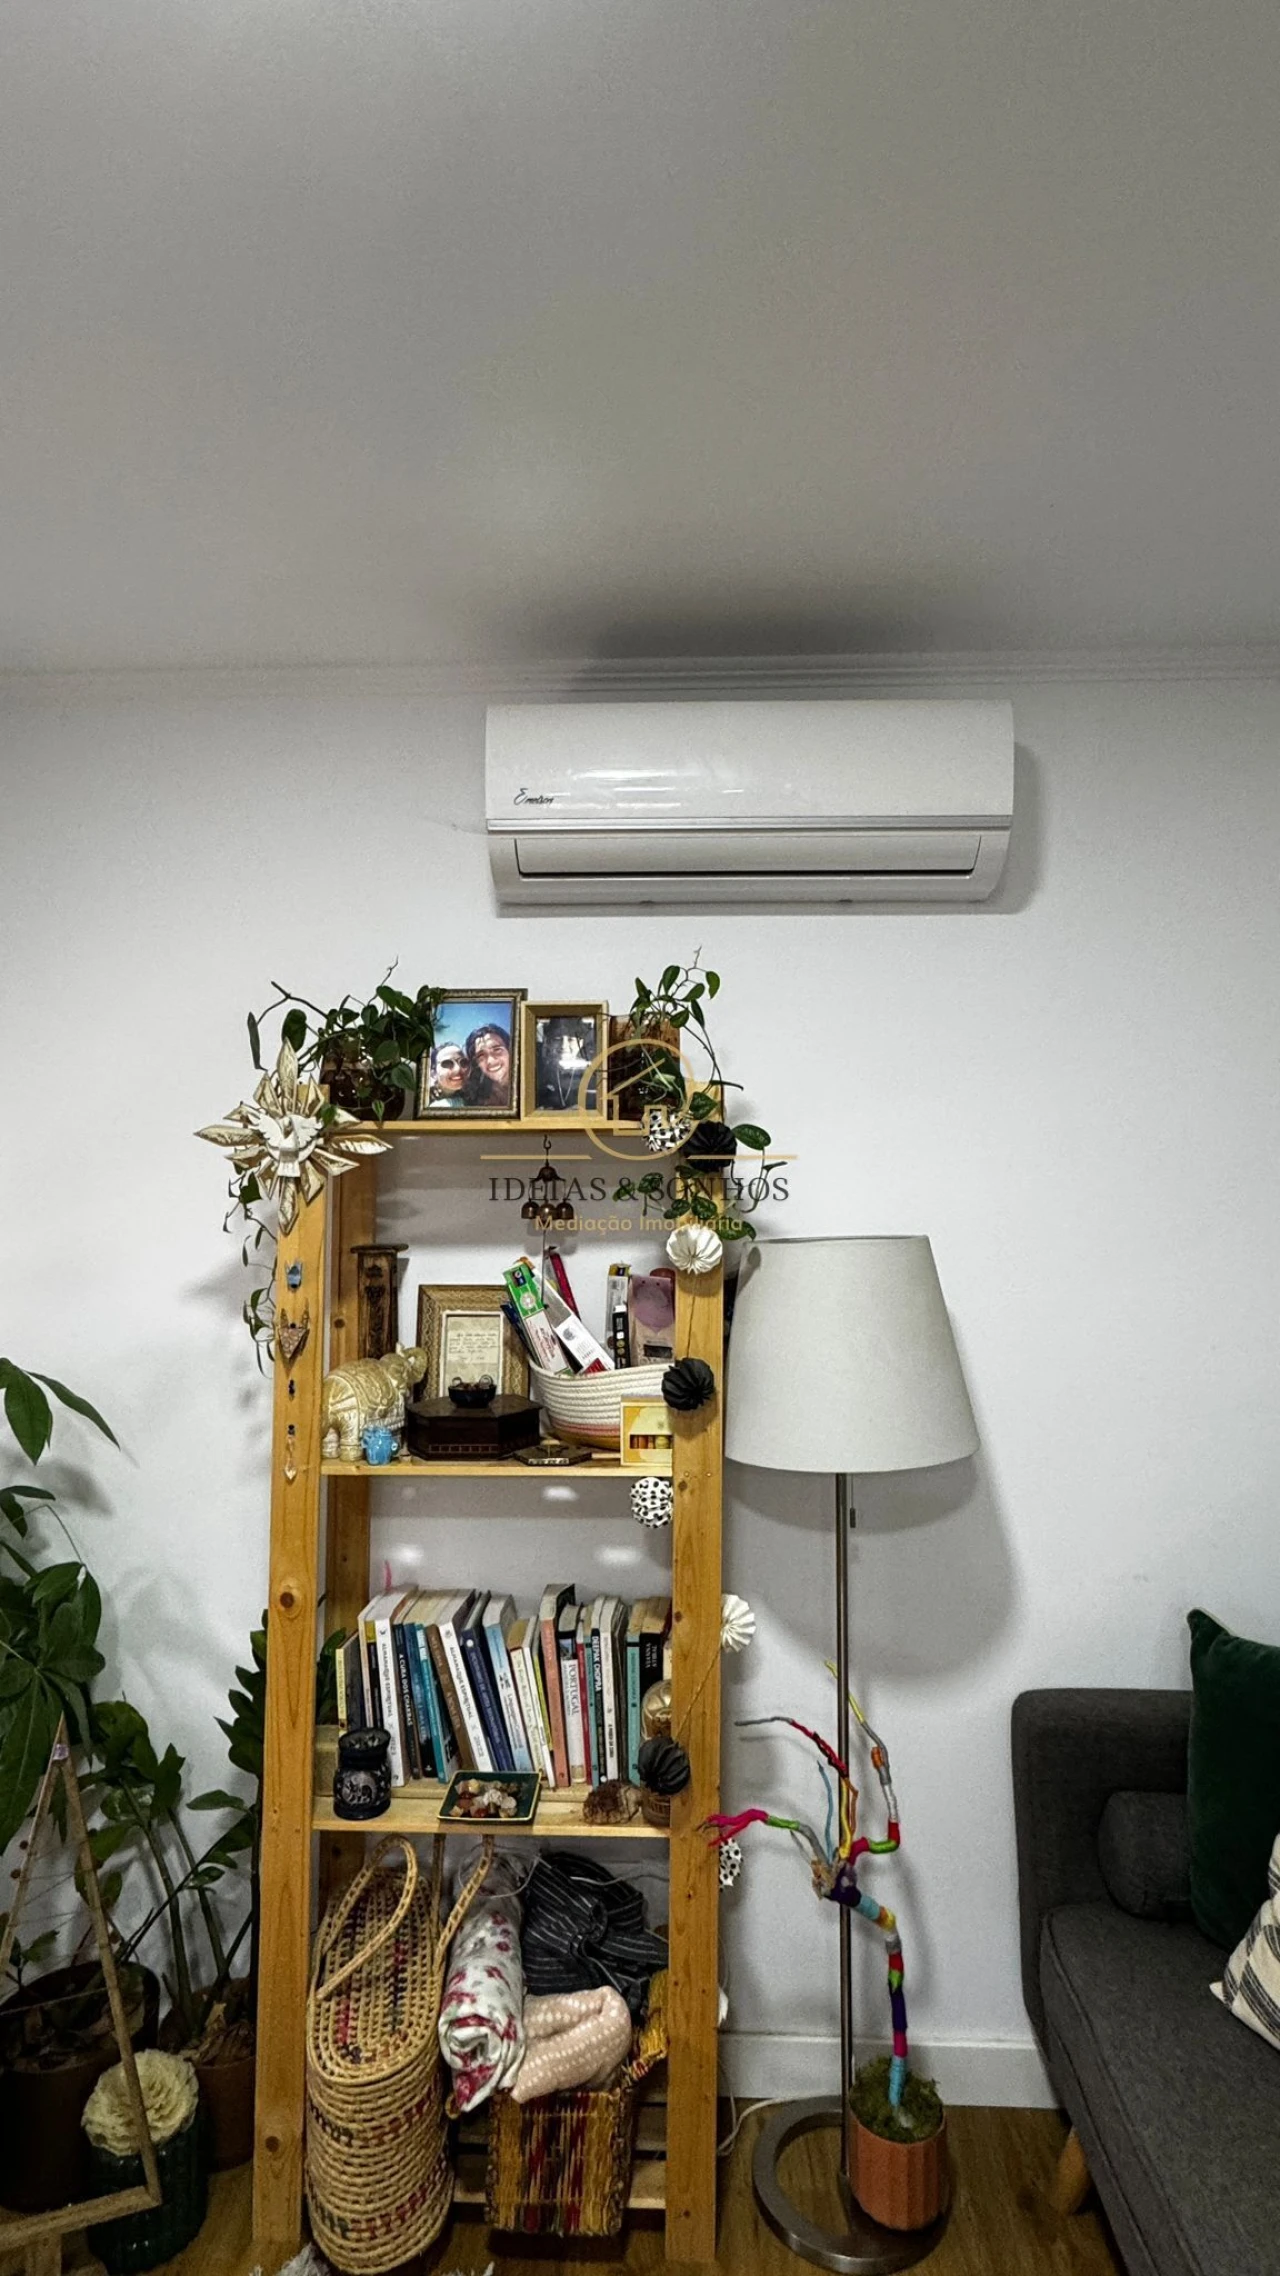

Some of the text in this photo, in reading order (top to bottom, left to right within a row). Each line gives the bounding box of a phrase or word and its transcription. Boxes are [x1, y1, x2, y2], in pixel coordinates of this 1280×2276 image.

[591, 1636, 600, 1662] DEEPAK
[399, 1660, 407, 1679] CURA
[593, 1663, 602, 1692] CHOPRA
[401, 1679, 409, 1694] DOS
[568, 1664, 580, 1716] PORTUGAL
[403, 1694, 413, 1726] CHAKRAS
